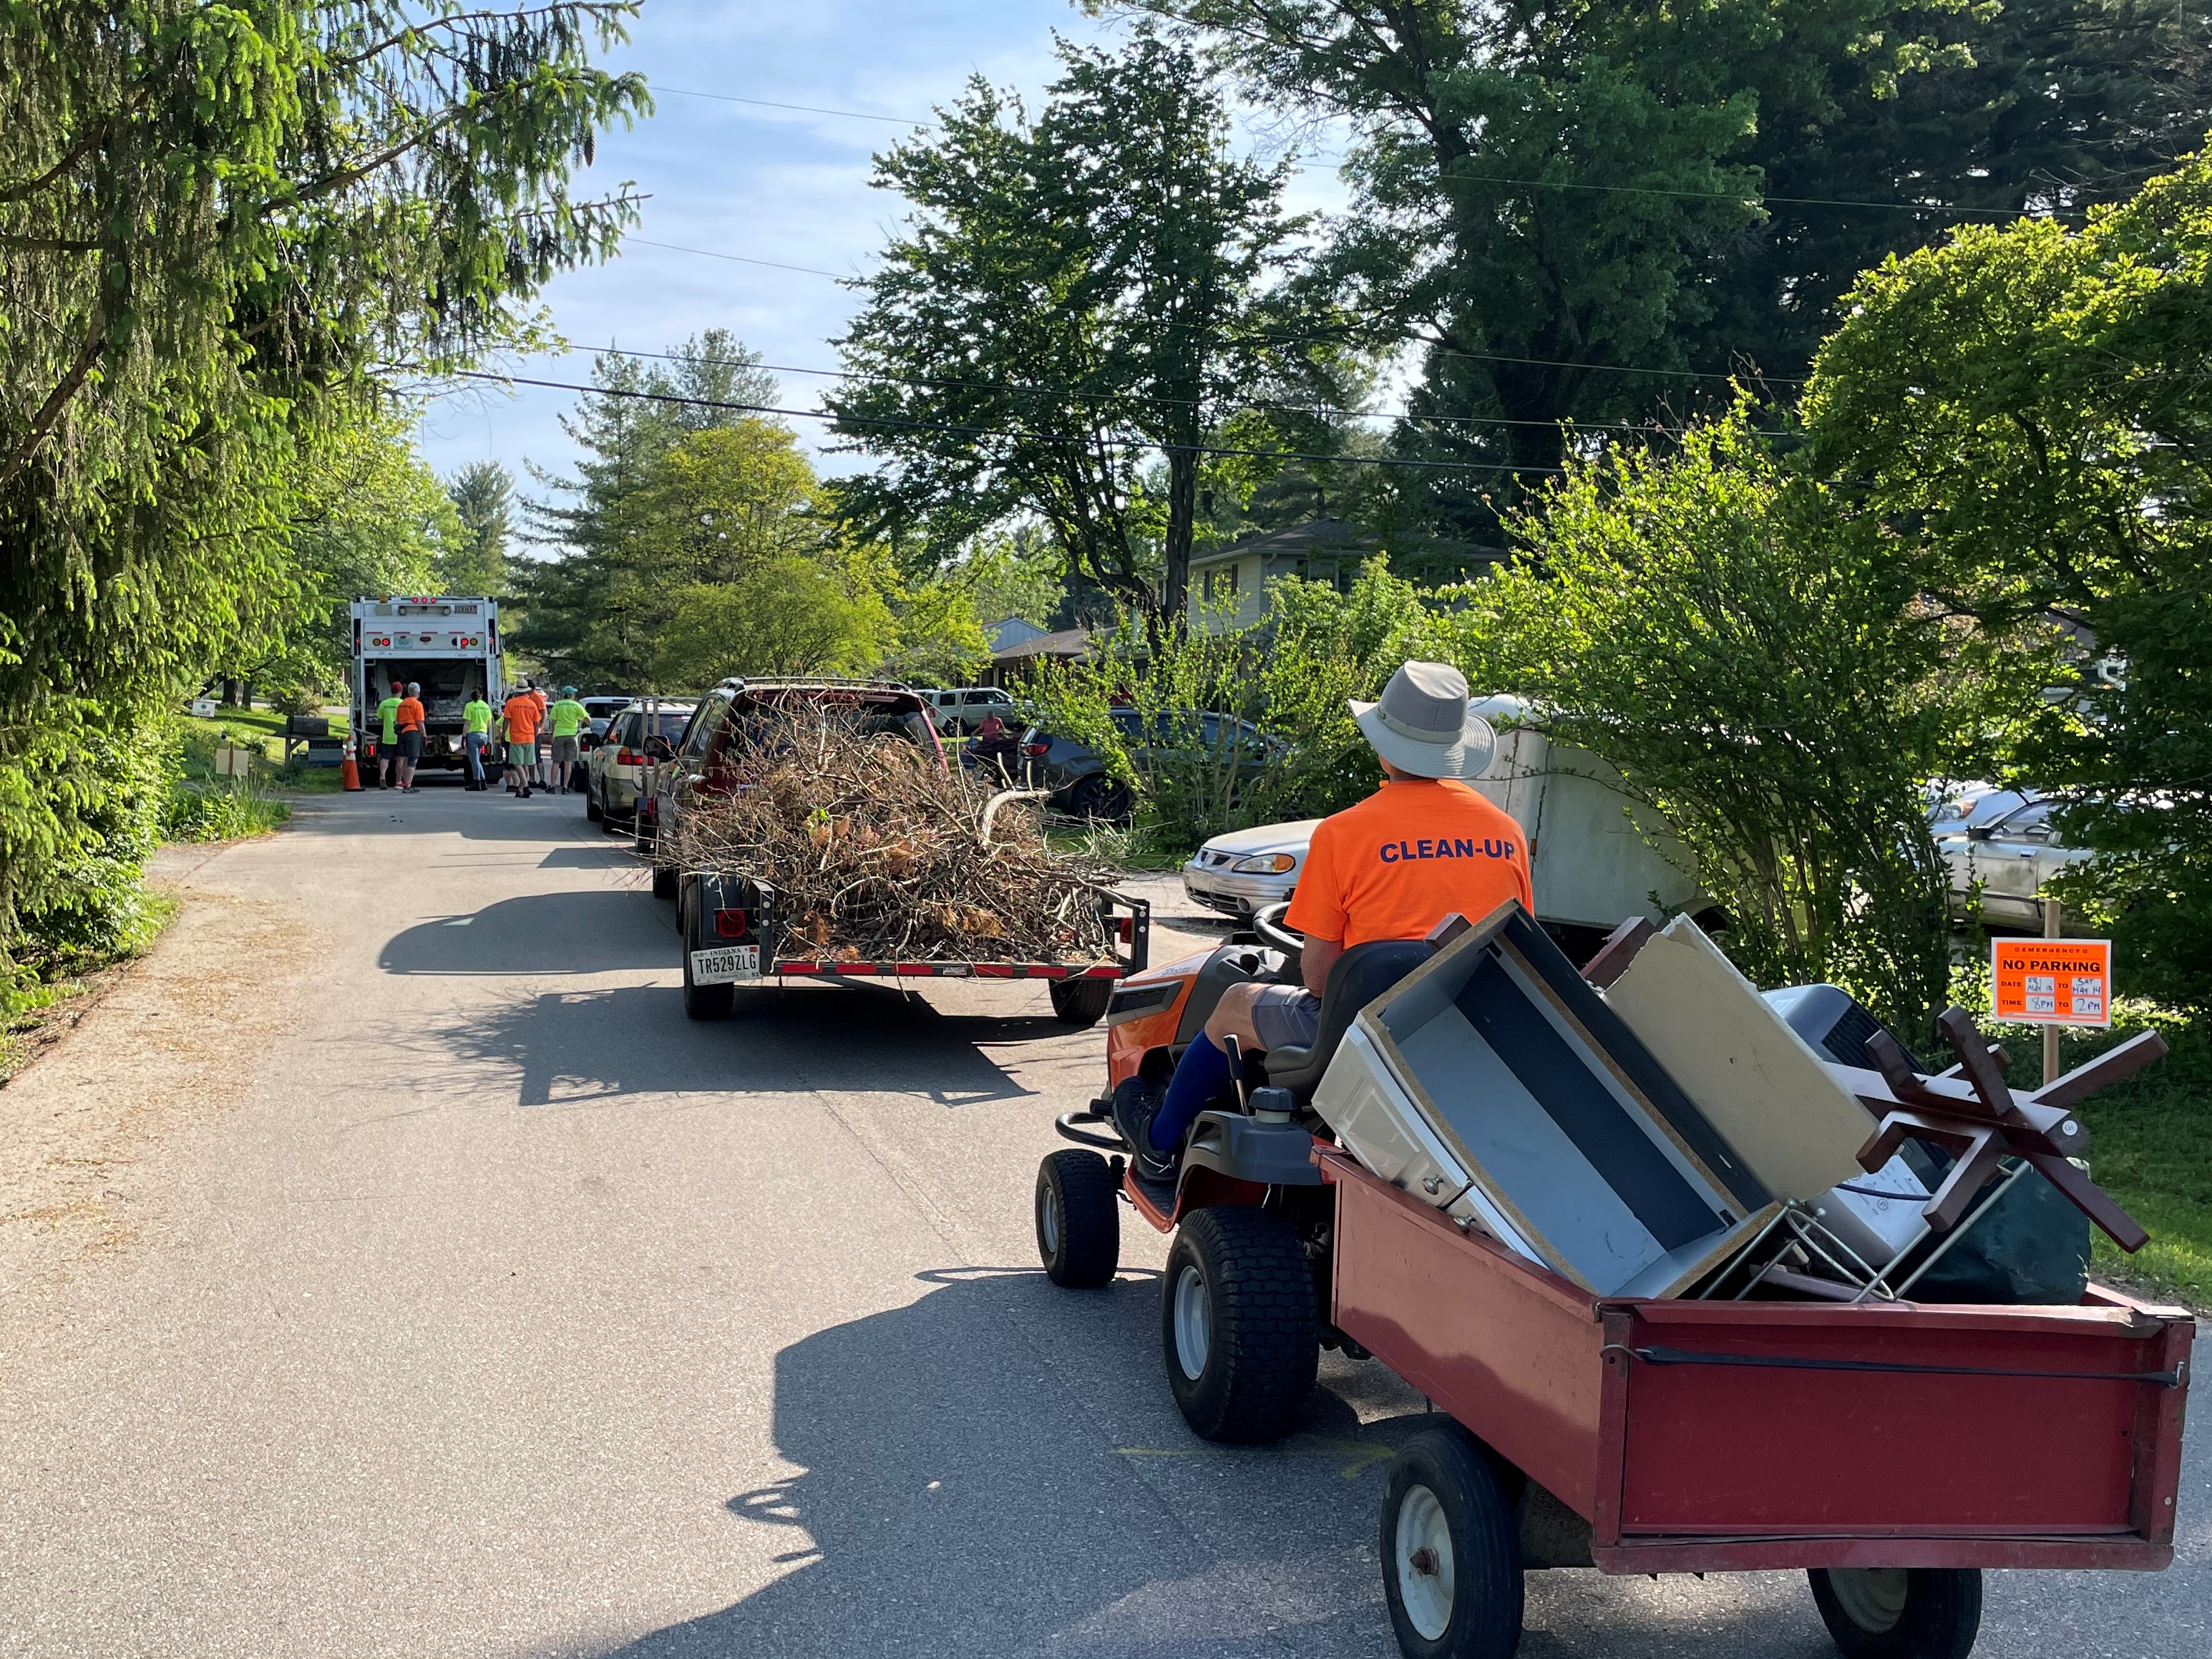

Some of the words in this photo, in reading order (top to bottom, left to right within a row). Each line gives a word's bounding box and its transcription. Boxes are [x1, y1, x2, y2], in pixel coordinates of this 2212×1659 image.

[1380, 839, 1515, 863] CLEAN-UP
[710, 948, 741, 956] INDIANA
[698, 954, 756, 974] TR529ZLG
[2003, 960, 2025, 970] NO
[2030, 960, 2101, 973] PARKING
